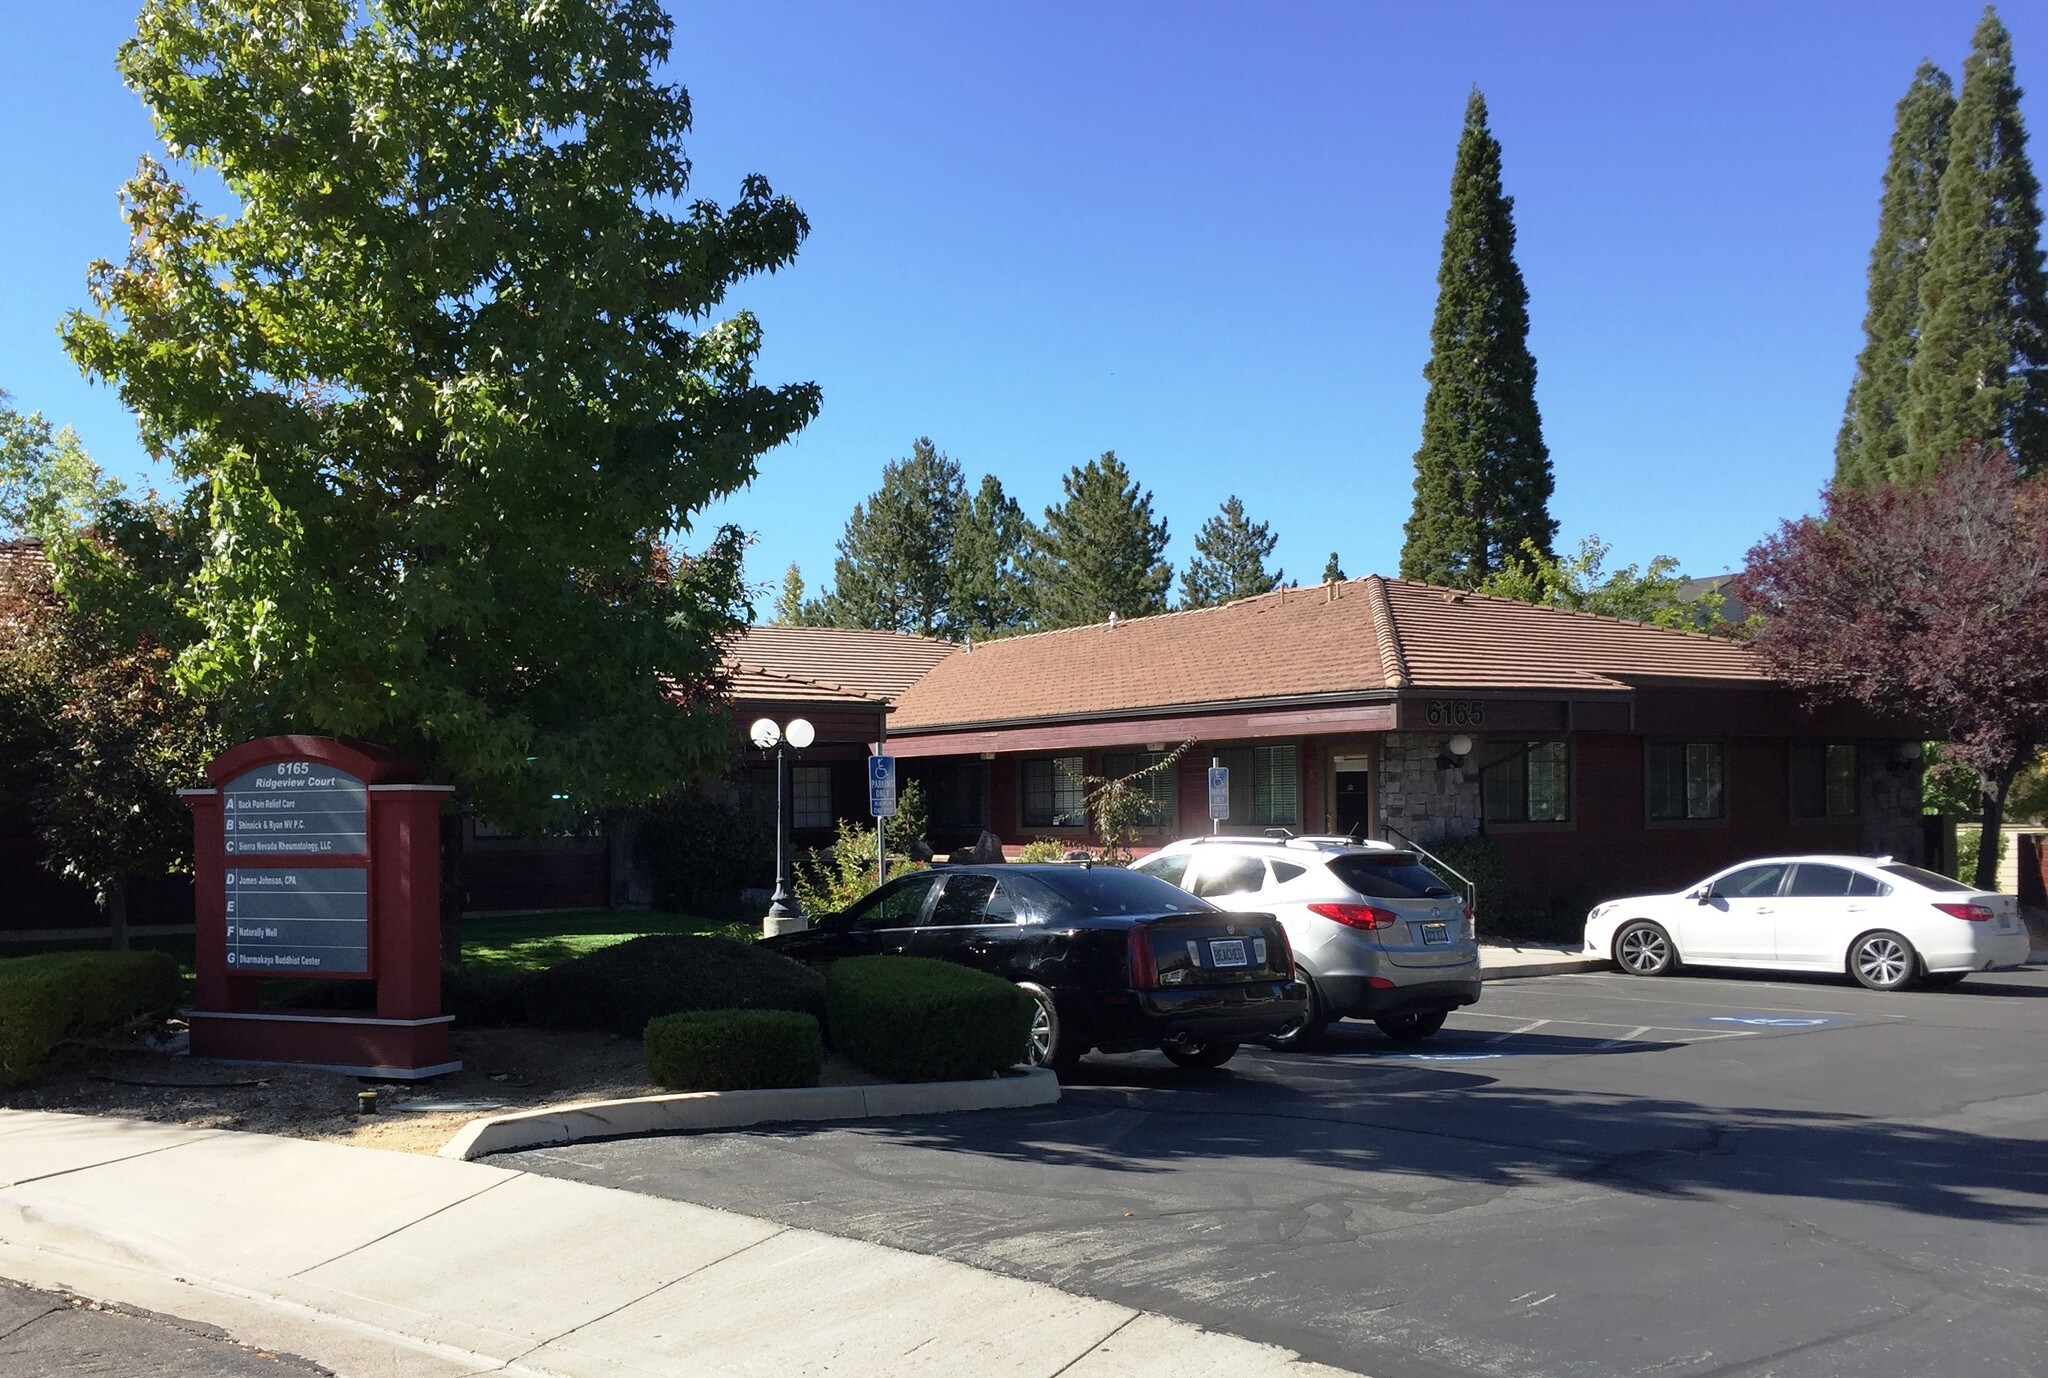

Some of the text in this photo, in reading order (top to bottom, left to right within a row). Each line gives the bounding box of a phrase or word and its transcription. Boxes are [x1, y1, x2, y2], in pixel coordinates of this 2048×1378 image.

[1425, 700, 1485, 726] 6165
[277, 762, 309, 775] 6165
[255, 776, 336, 790] Ridgeview Court
[225, 798, 296, 810] A Back Pain Relief Care
[226, 819, 234, 831] B
[262, 820, 268, 829] &
[269, 820, 283, 831] Ryan
[284, 820, 293, 829] NV
[226, 840, 332, 852] C Sierra Nevada Rheumatology, LLC
[226, 873, 297, 887] D James Johnson, CPA
[226, 900, 235, 912] E
[226, 925, 278, 939] F Naturally Well
[227, 952, 321, 966] G Dharmakaya Buddhist Center
